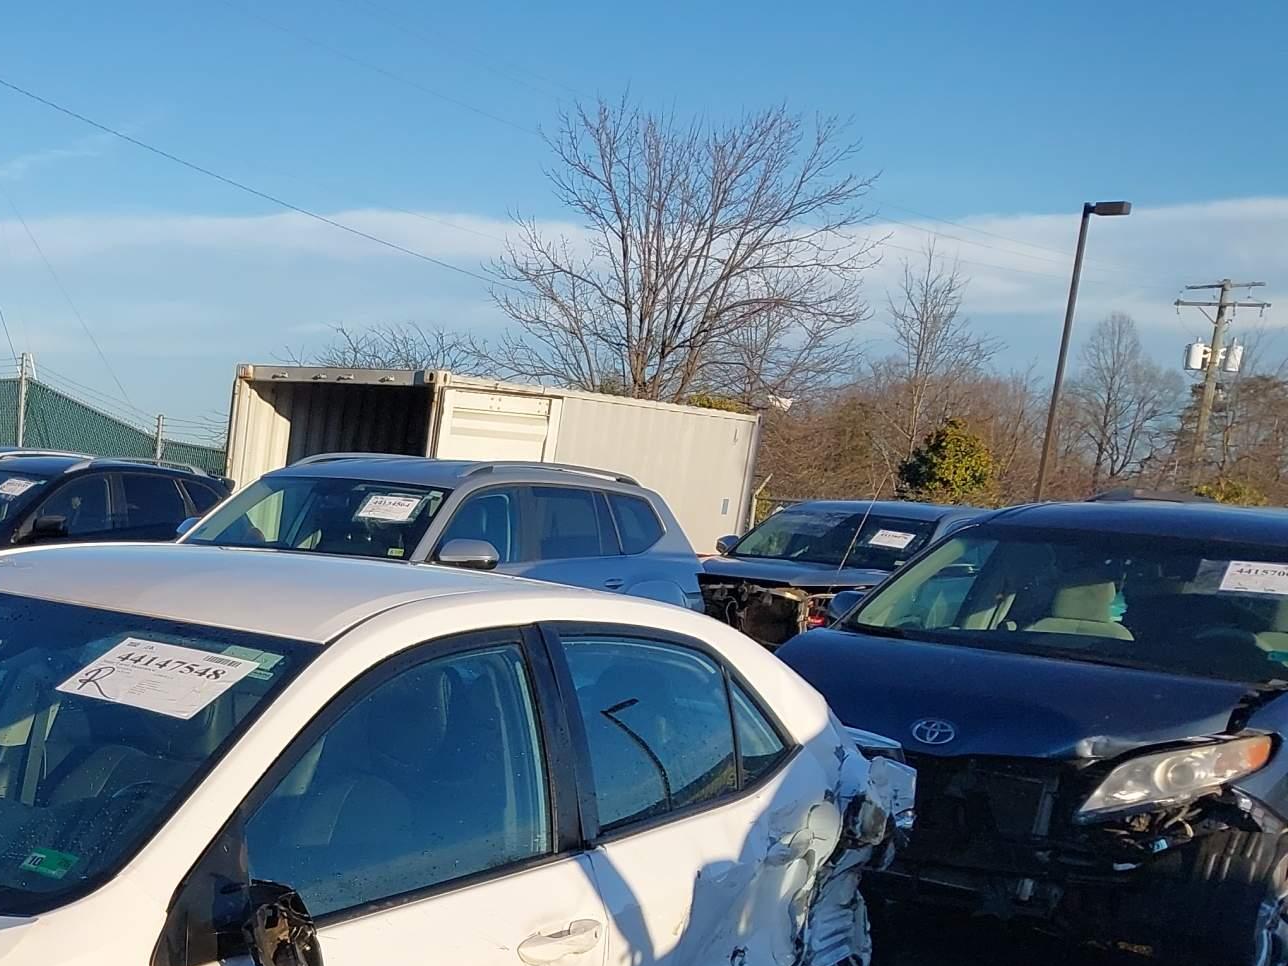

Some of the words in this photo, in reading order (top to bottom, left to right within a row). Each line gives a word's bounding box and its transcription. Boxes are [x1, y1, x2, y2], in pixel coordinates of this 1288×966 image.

[1236, 567, 1288, 577] 441570
[117, 651, 227, 681] 44147548
[76, 666, 117, 700] R
[28, 855, 44, 866] 10
